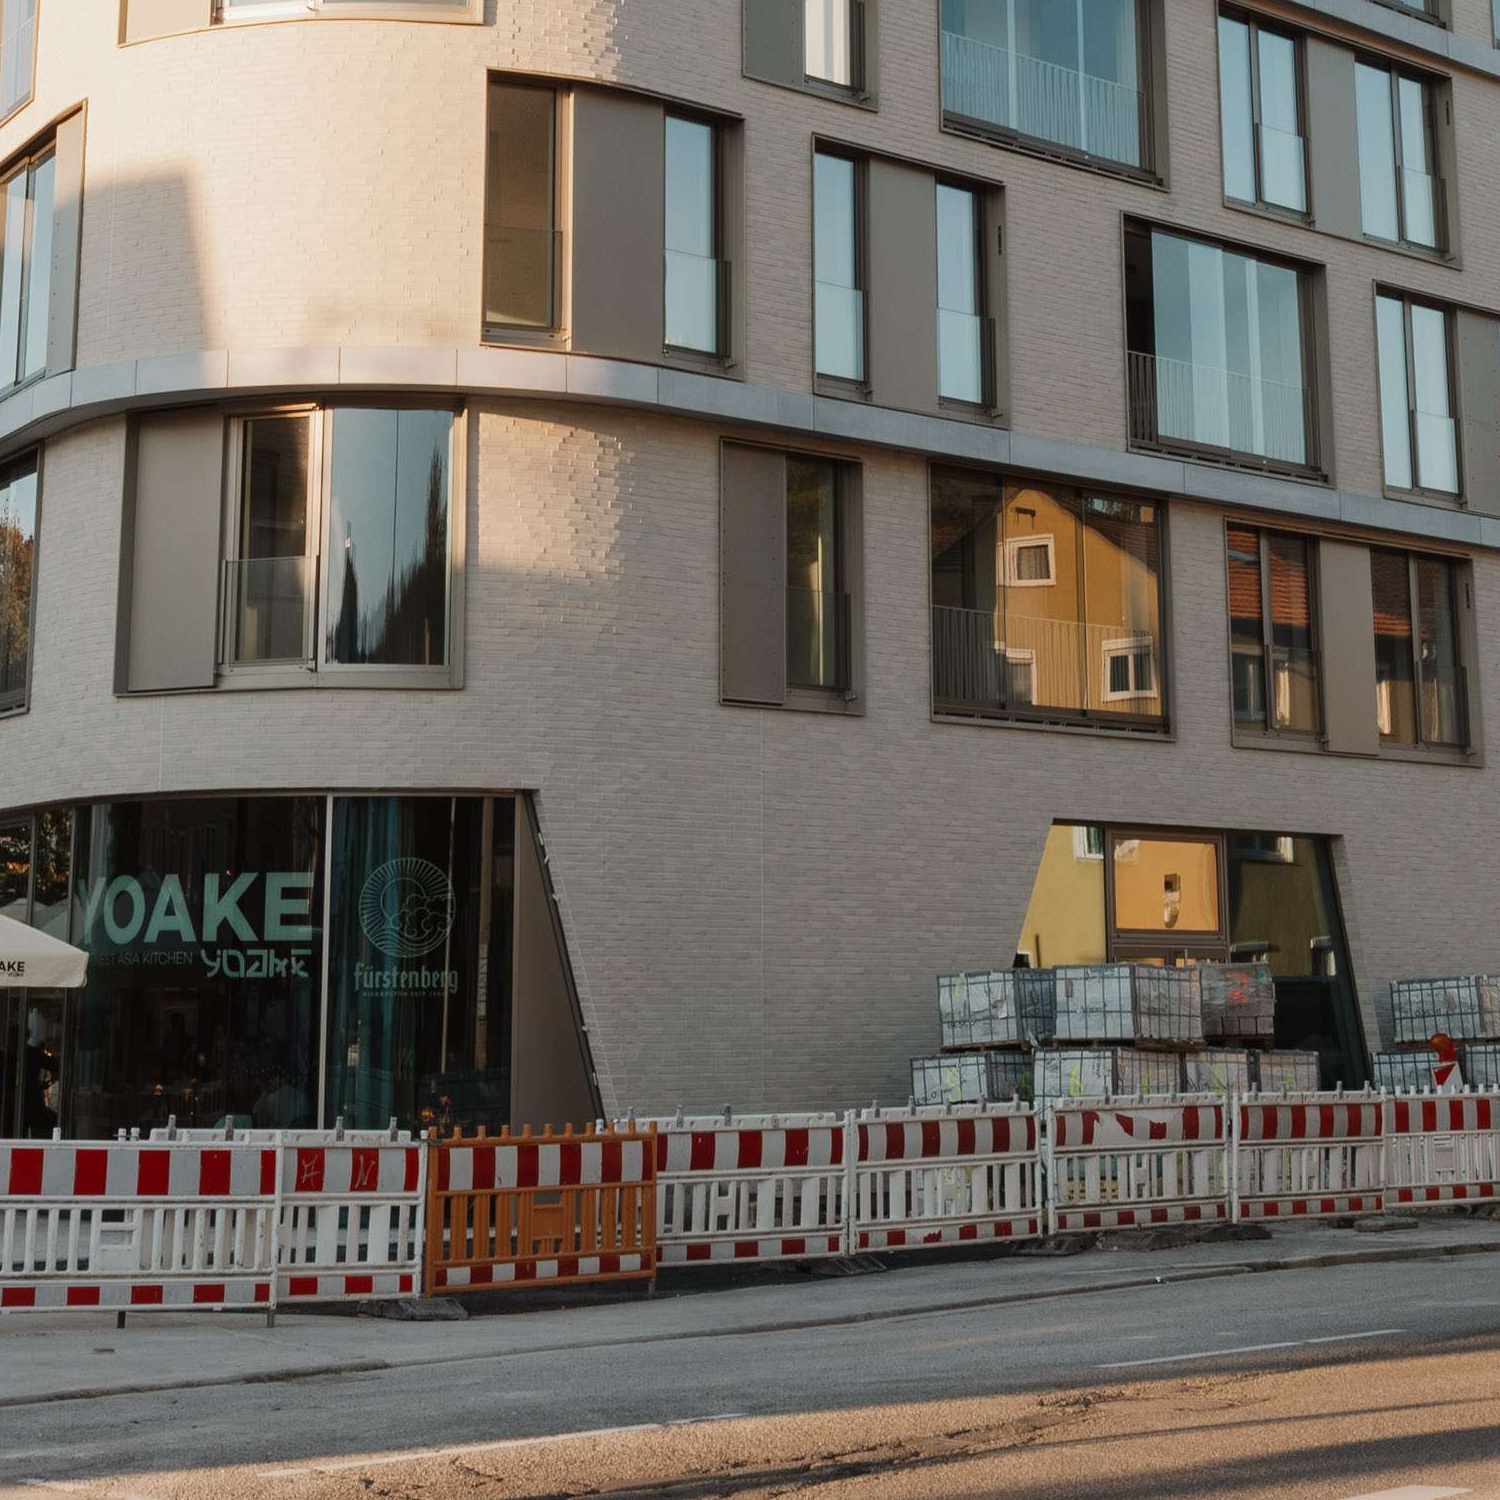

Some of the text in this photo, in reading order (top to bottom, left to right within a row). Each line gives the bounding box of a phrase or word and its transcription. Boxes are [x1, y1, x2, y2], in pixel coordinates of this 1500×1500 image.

[77, 872, 314, 945] YOAKE
[118, 953, 140, 965] ASIA
[143, 951, 193, 964] KITCHEN
[354, 962, 458, 993] fürstenberg
